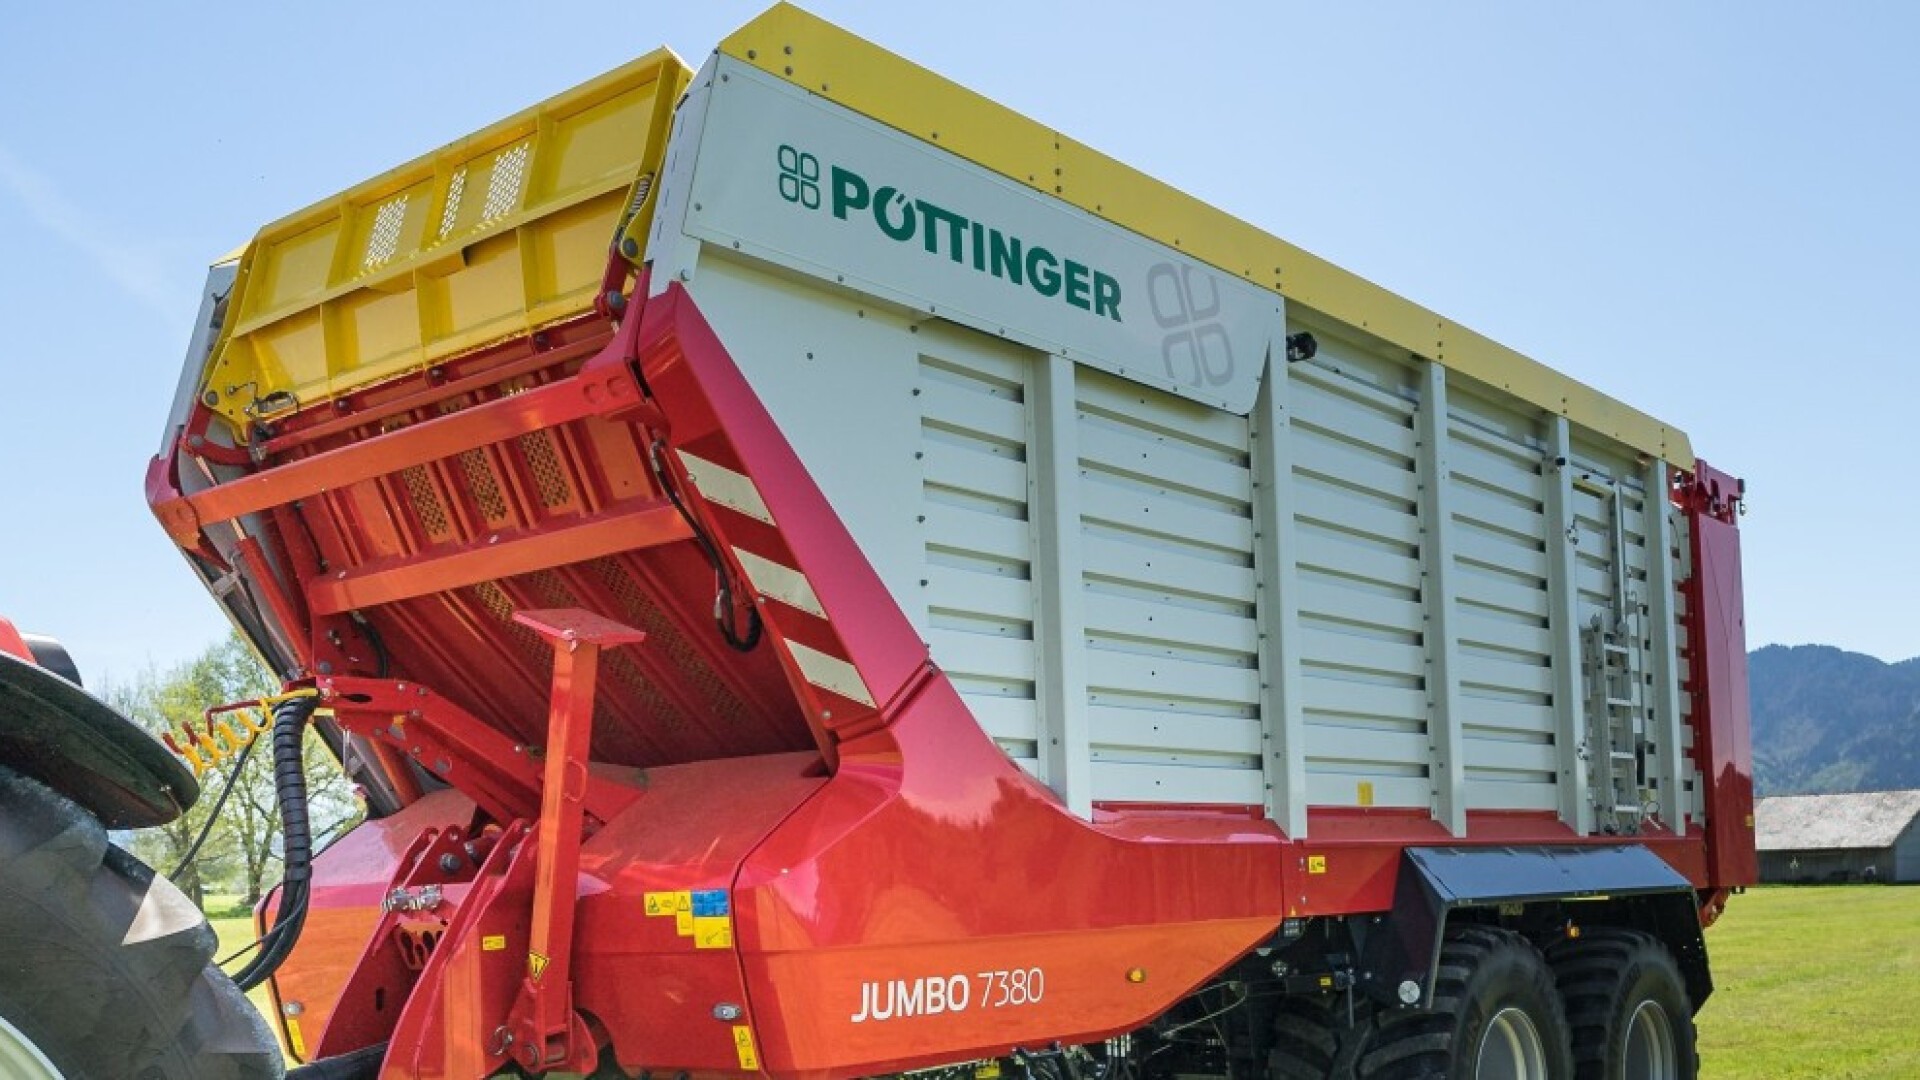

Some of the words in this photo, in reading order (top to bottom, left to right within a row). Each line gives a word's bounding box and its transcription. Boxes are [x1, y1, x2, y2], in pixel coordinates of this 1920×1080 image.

[831, 165, 1121, 322] PÖTTINGER
[851, 974, 970, 1023] JUMBO
[977, 966, 1044, 1008] 7380
